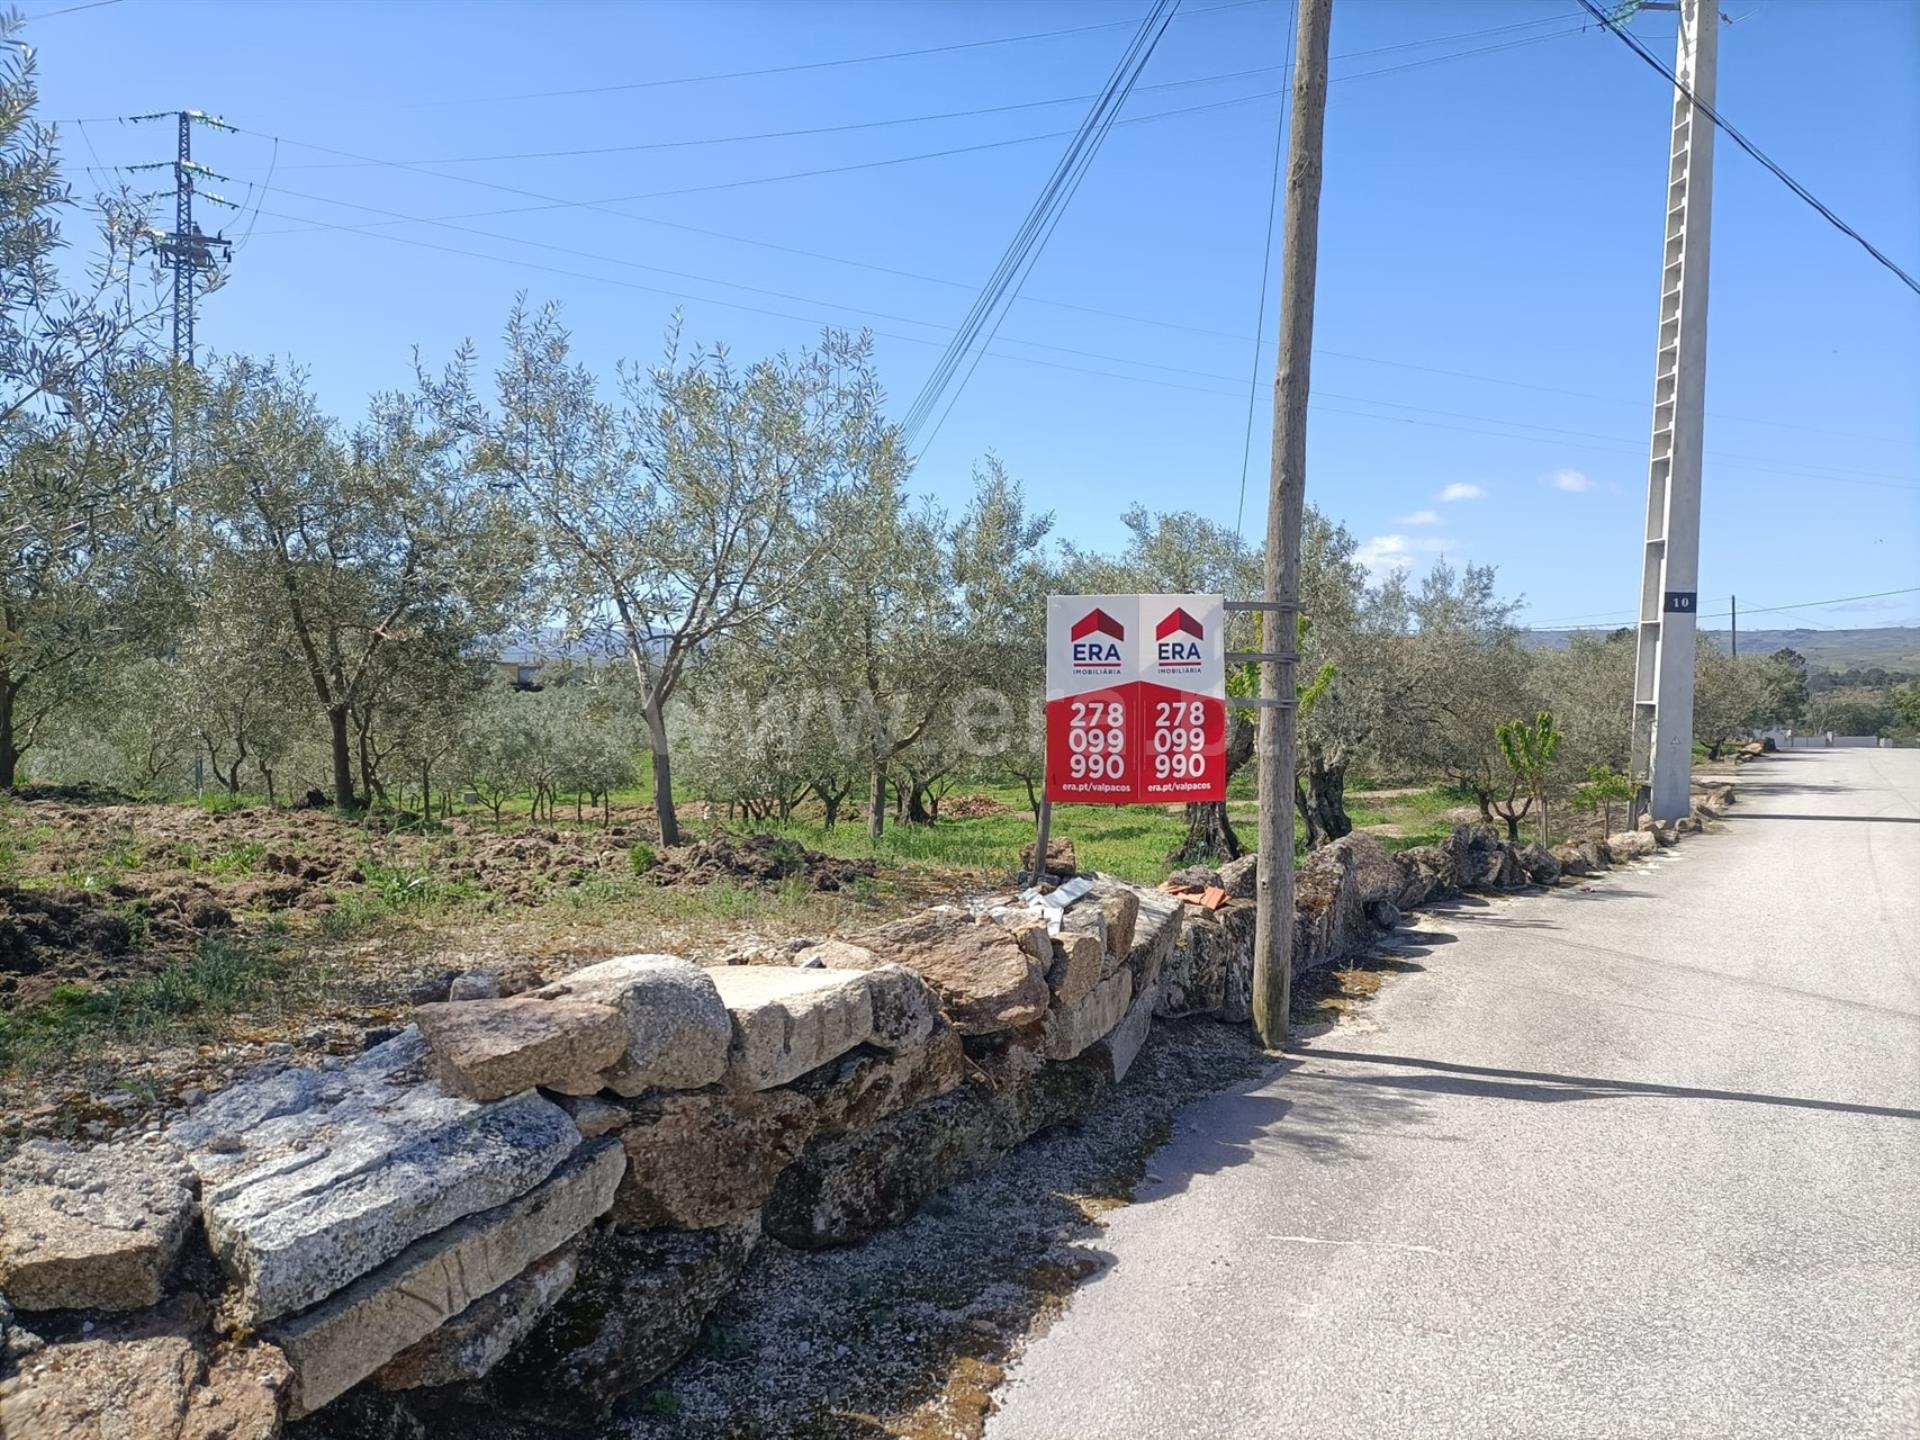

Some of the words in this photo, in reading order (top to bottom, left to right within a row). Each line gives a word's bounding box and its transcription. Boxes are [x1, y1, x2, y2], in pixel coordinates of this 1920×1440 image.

[1673, 598, 1689, 608] 10
[1073, 643, 1121, 661] ERA
[1158, 642, 1201, 660] ERA
[1070, 702, 1124, 727] 278
[1155, 701, 1205, 727] 278
[1068, 728, 1125, 753] 099
[1154, 727, 1205, 753] 099
[1070, 753, 1125, 779] 990
[1155, 753, 1206, 779] 990
[1062, 783, 1131, 792] era.pt/valpacos
[1147, 781, 1211, 792] era.pt/valpacos
